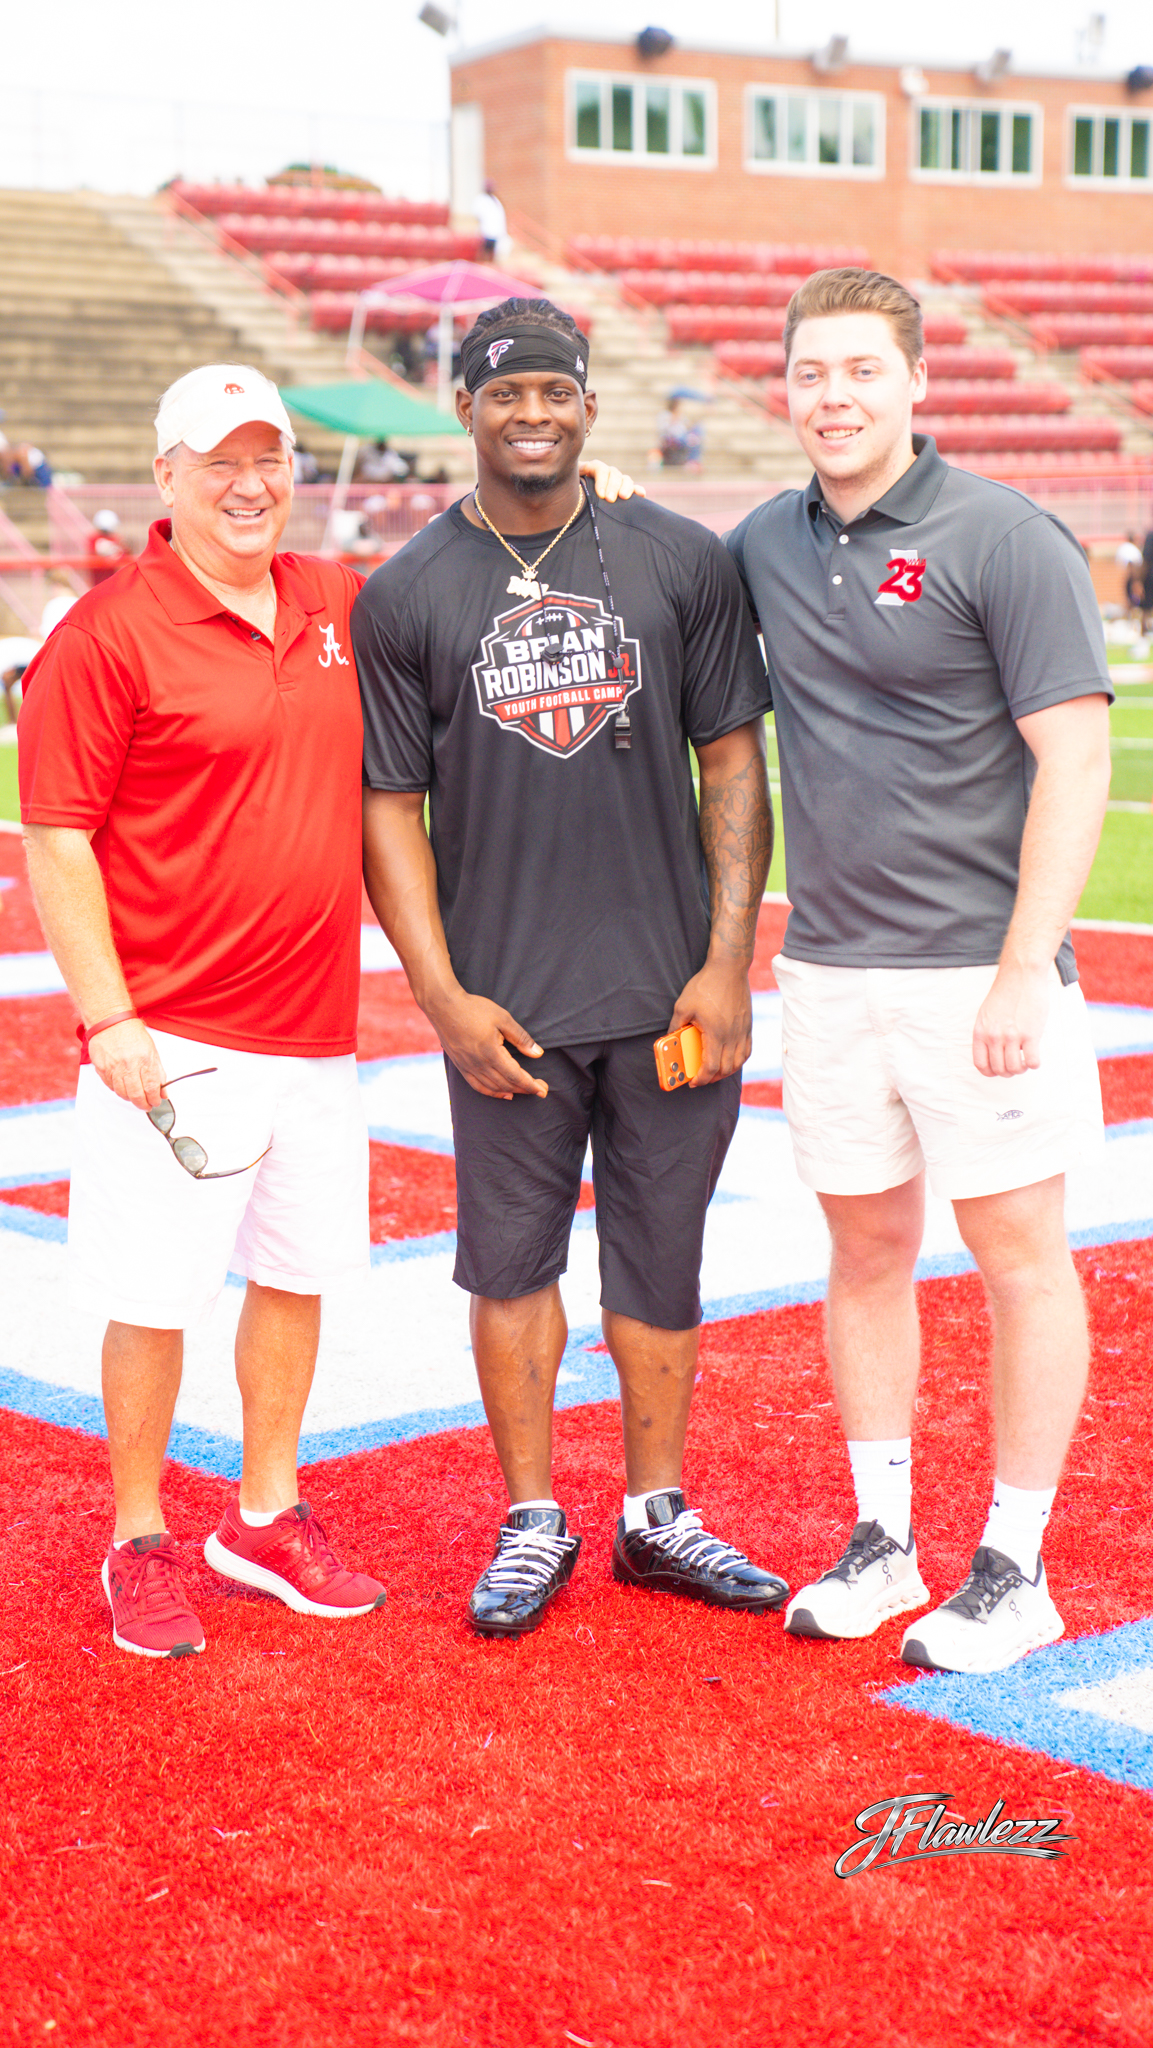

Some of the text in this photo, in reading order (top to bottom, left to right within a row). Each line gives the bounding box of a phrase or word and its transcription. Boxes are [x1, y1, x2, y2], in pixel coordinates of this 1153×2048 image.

[878, 558, 926, 602] 23
[481, 650, 606, 699] ROBINSON
[504, 686, 622, 716] YOUTH FOOTBALL CAMP
